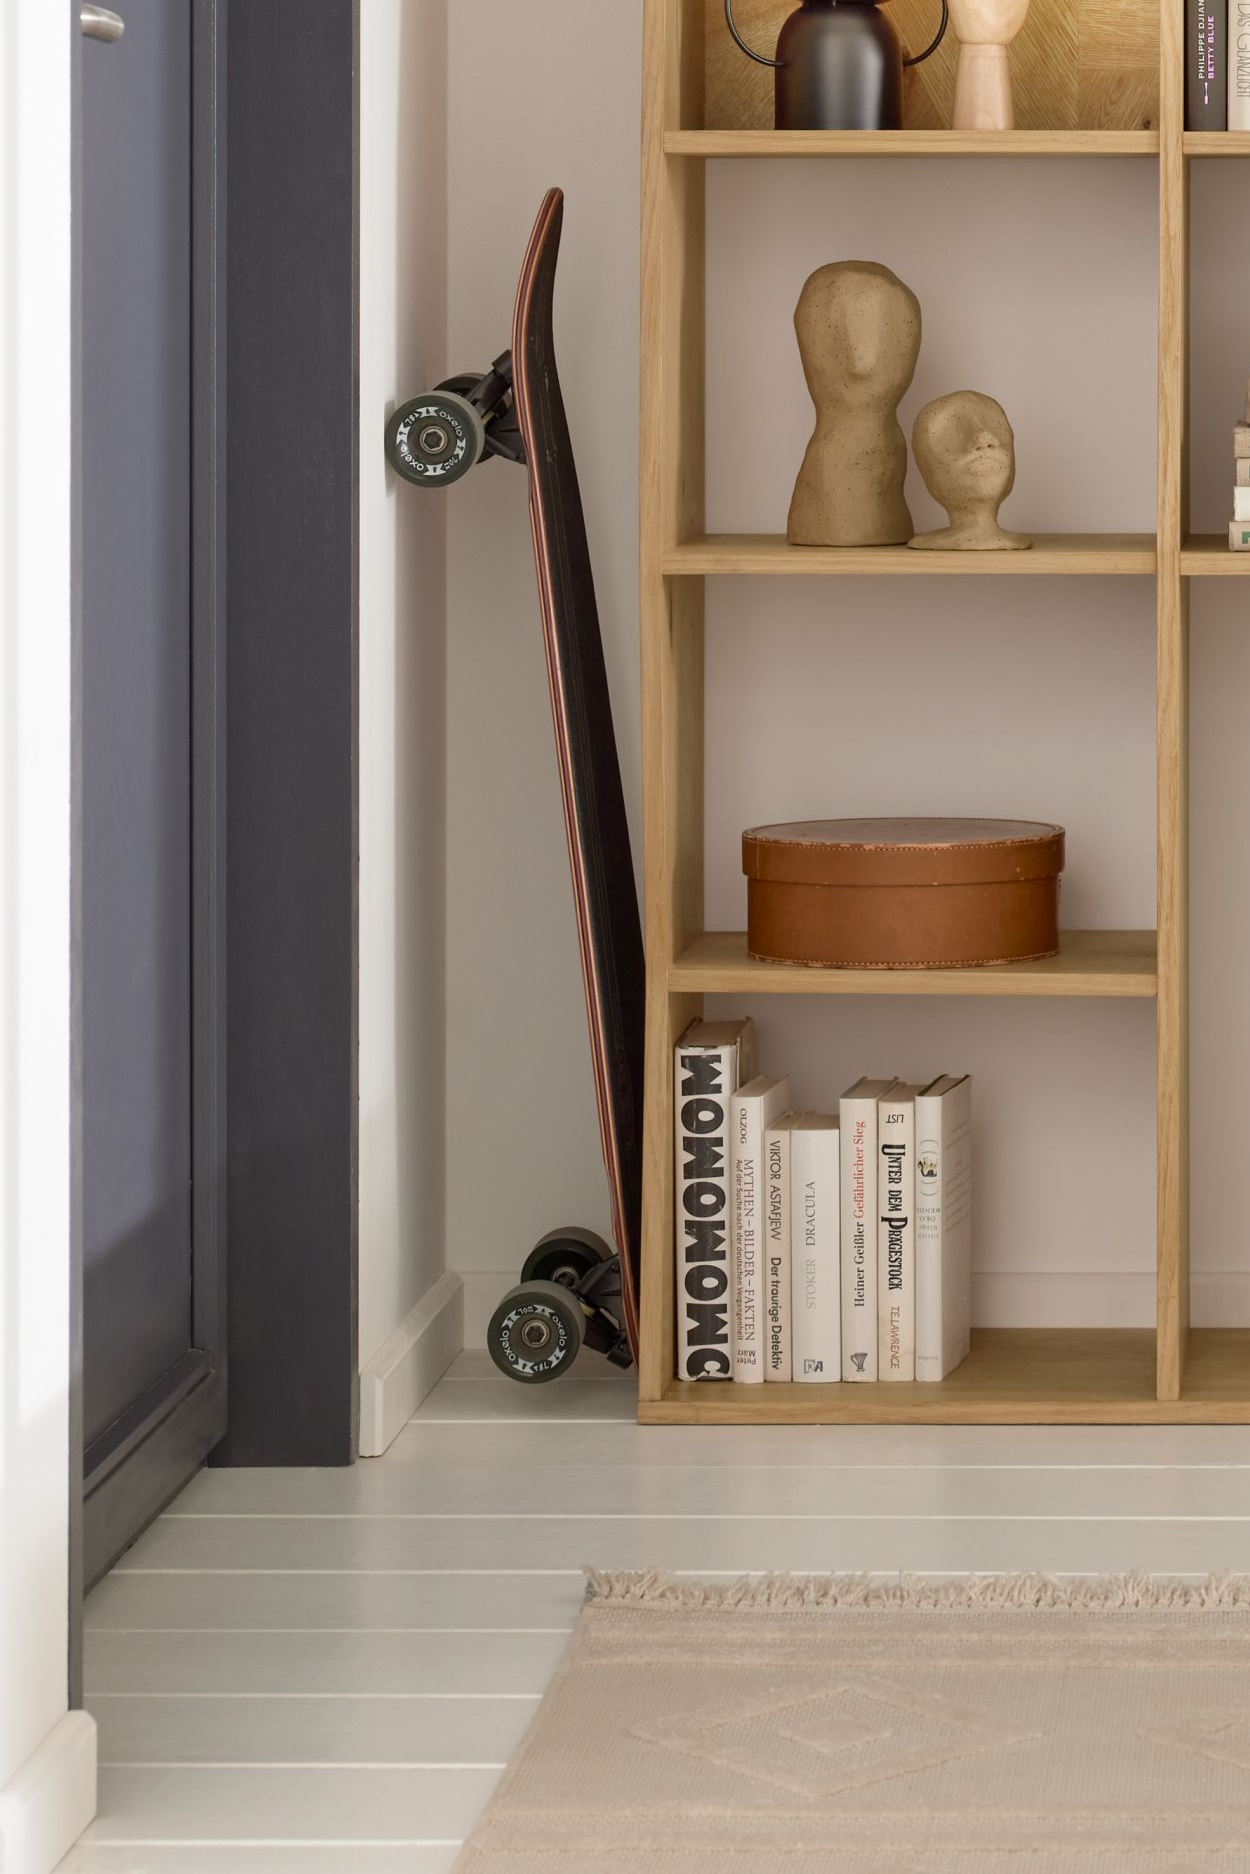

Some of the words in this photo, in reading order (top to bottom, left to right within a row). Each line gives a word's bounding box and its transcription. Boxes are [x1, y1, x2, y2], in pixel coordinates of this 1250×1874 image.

[1207, 16, 1215, 43] BLUE
[1207, 47, 1215, 79] BETTY
[439, 411, 463, 437] oxelo
[400, 444, 424, 471] oxelo
[739, 1108, 748, 1145] OLZOG
[853, 1120, 867, 1145] Sieg
[886, 1114, 904, 1124] LIST
[735, 1159, 743, 1172] Auf
[769, 1140, 782, 1180] VIKTOR
[881, 1143, 906, 1184] UNTER
[735, 1173, 743, 1186] der
[735, 1187, 743, 1210] Suche
[744, 1159, 754, 1217] MYTHEN
[853, 1147, 864, 1219] Gefährlicher
[768, 1185, 782, 1241] ASTAFJEW
[805, 1181, 816, 1246] DRACULA
[888, 1190, 902, 1212] DEM
[735, 1212, 743, 1230] nach
[744, 1229, 755, 1277] BILDER
[853, 1221, 865, 1265] Geißler
[880, 1216, 908, 1291] PRÄGESTOCK
[770, 1257, 782, 1278] Der
[805, 1258, 817, 1310] STOKER
[768, 1280, 782, 1324] traurige
[853, 1267, 865, 1307] Heiner
[552, 1315, 568, 1347] oxelo
[735, 1287, 744, 1341] Vergangenheit
[744, 1289, 755, 1341] FAKTEN
[499, 1330, 516, 1362] oxelo
[770, 1326, 783, 1370] Detektiv
